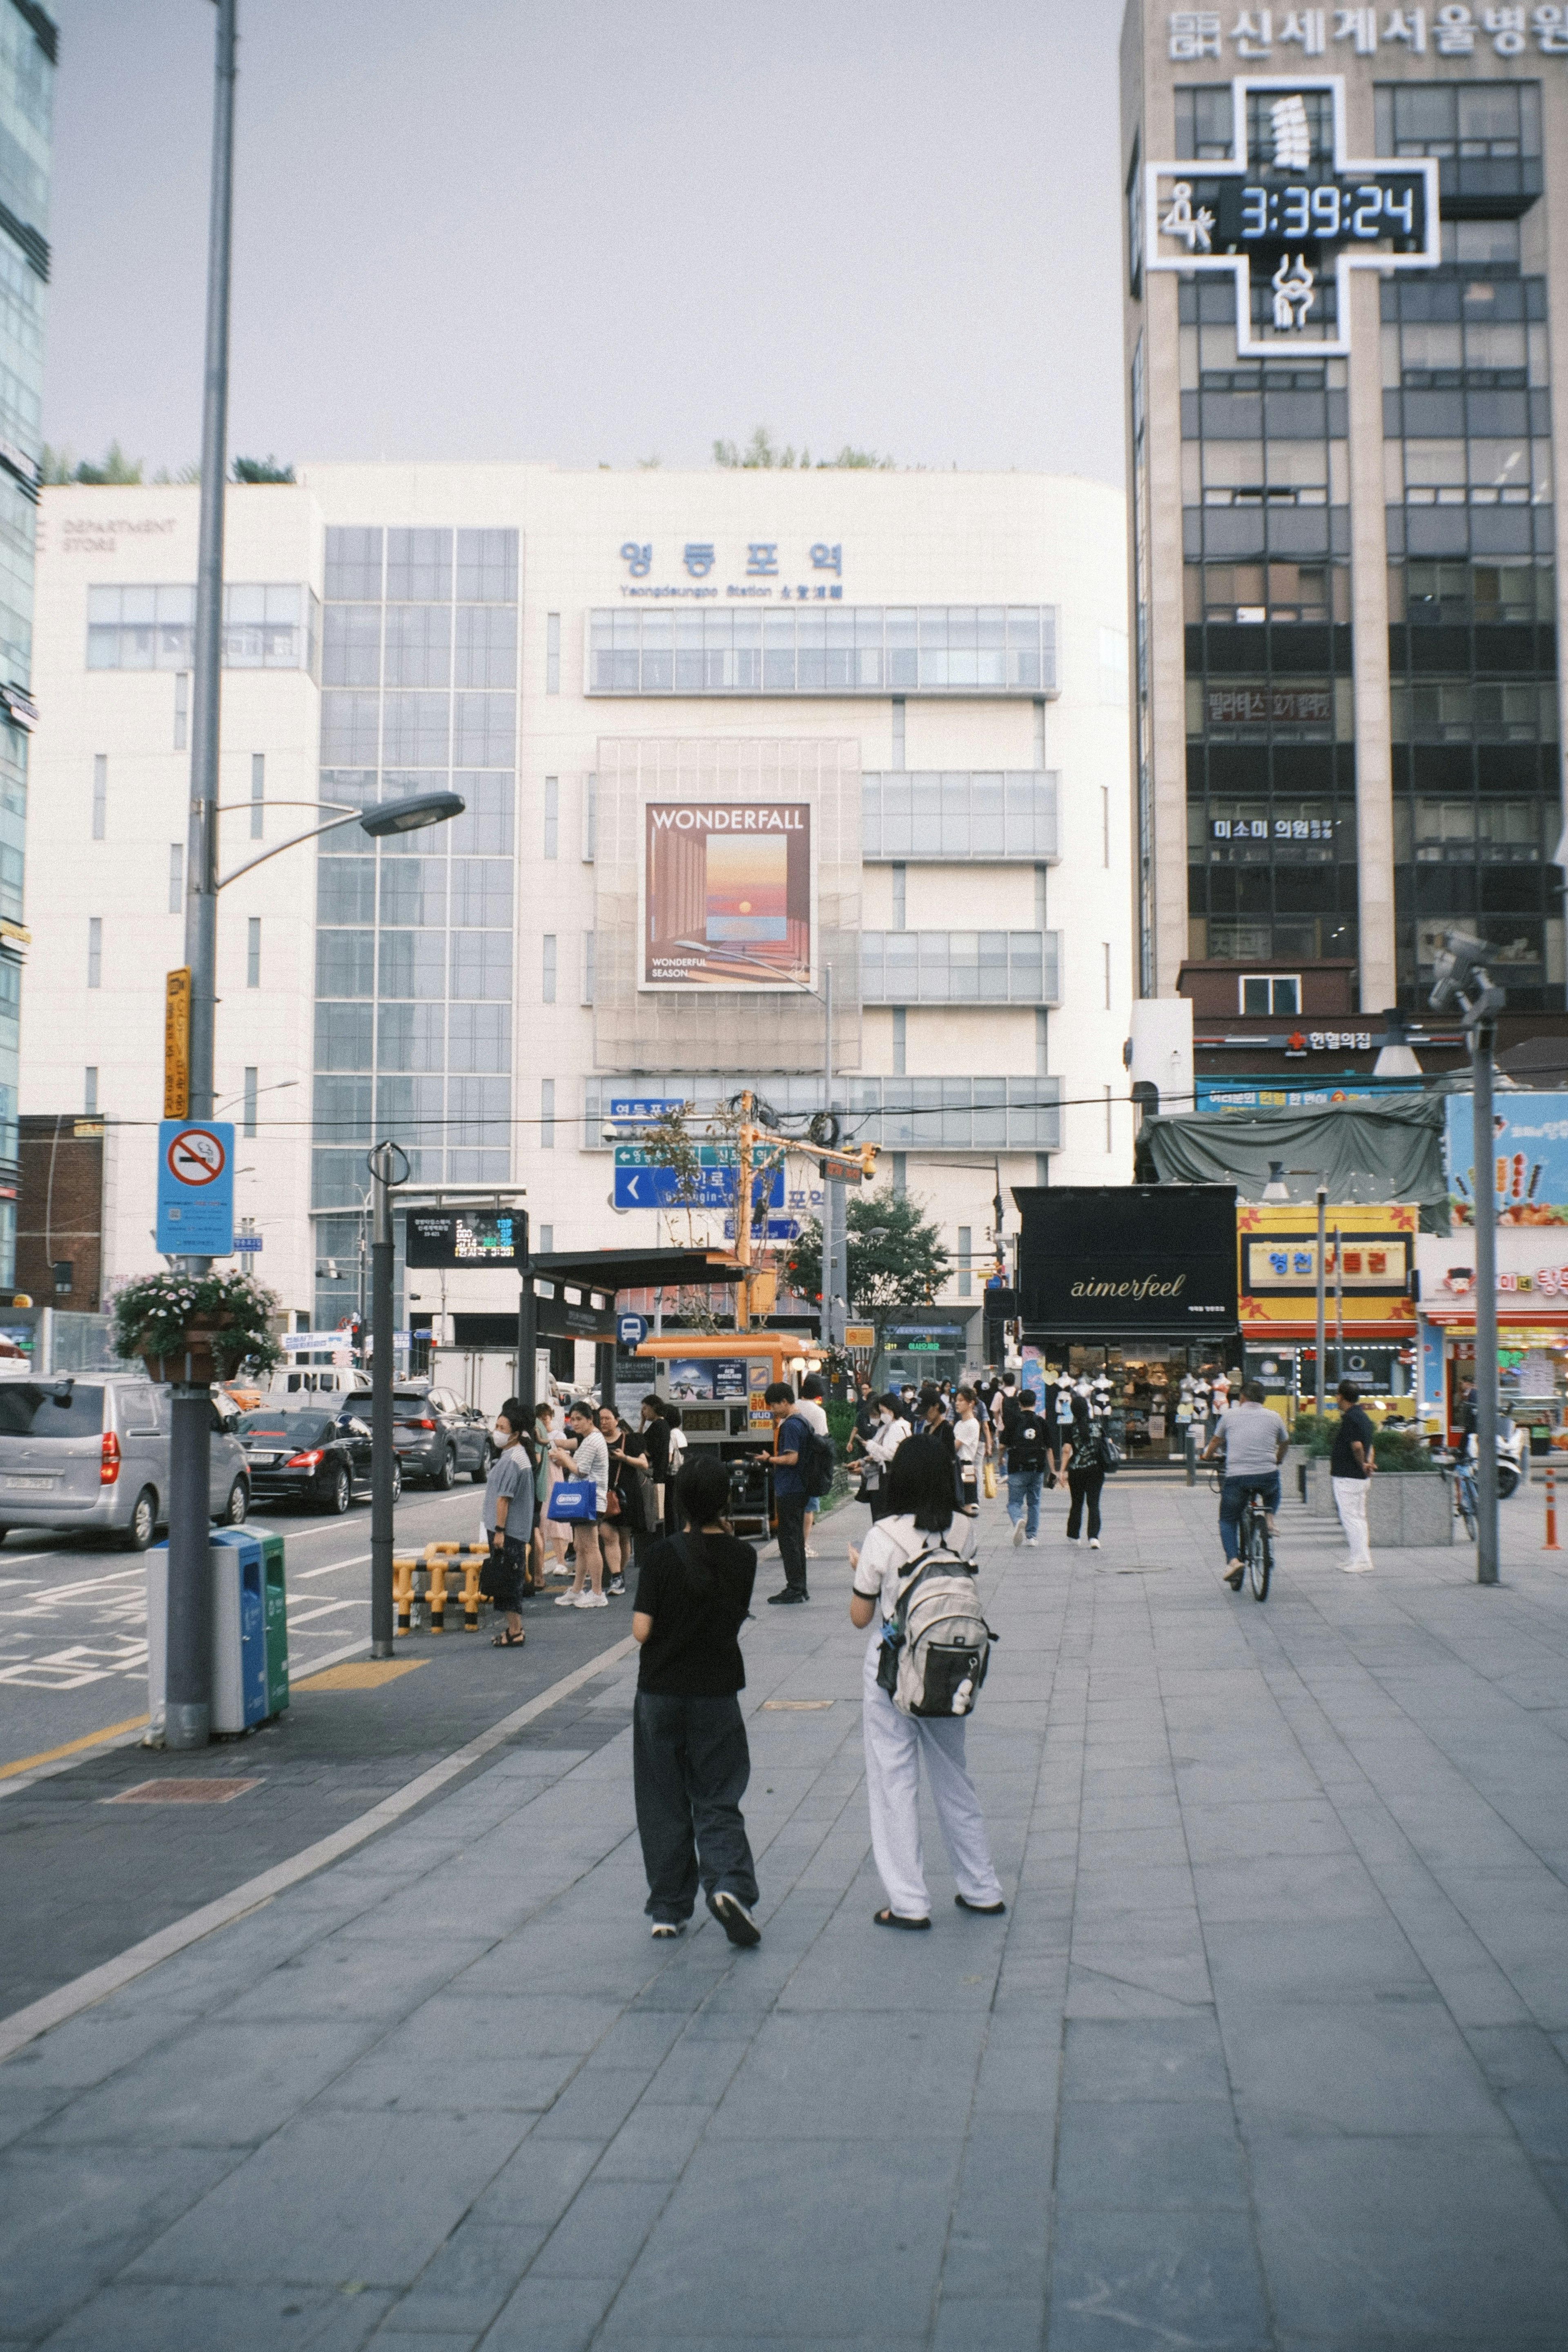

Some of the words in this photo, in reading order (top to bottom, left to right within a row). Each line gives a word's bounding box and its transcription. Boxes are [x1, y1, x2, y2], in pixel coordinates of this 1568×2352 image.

[1229, 4, 1568, 58] 신세계서울병원
[1241, 186, 1412, 238] 3:39:24
[619, 541, 843, 577] 영등포역
[652, 810, 804, 830] WONDERFALL
[1214, 820, 1268, 839] 미소미
[1274, 820, 1309, 839] 의원
[652, 958, 707, 967] WONDERFUL
[652, 969, 688, 978] SEASON
[1308, 1031, 1371, 1049] 헌혈의집
[1269, 1252, 1312, 1274] 영천
[1071, 1274, 1186, 1301] aimerfeel
